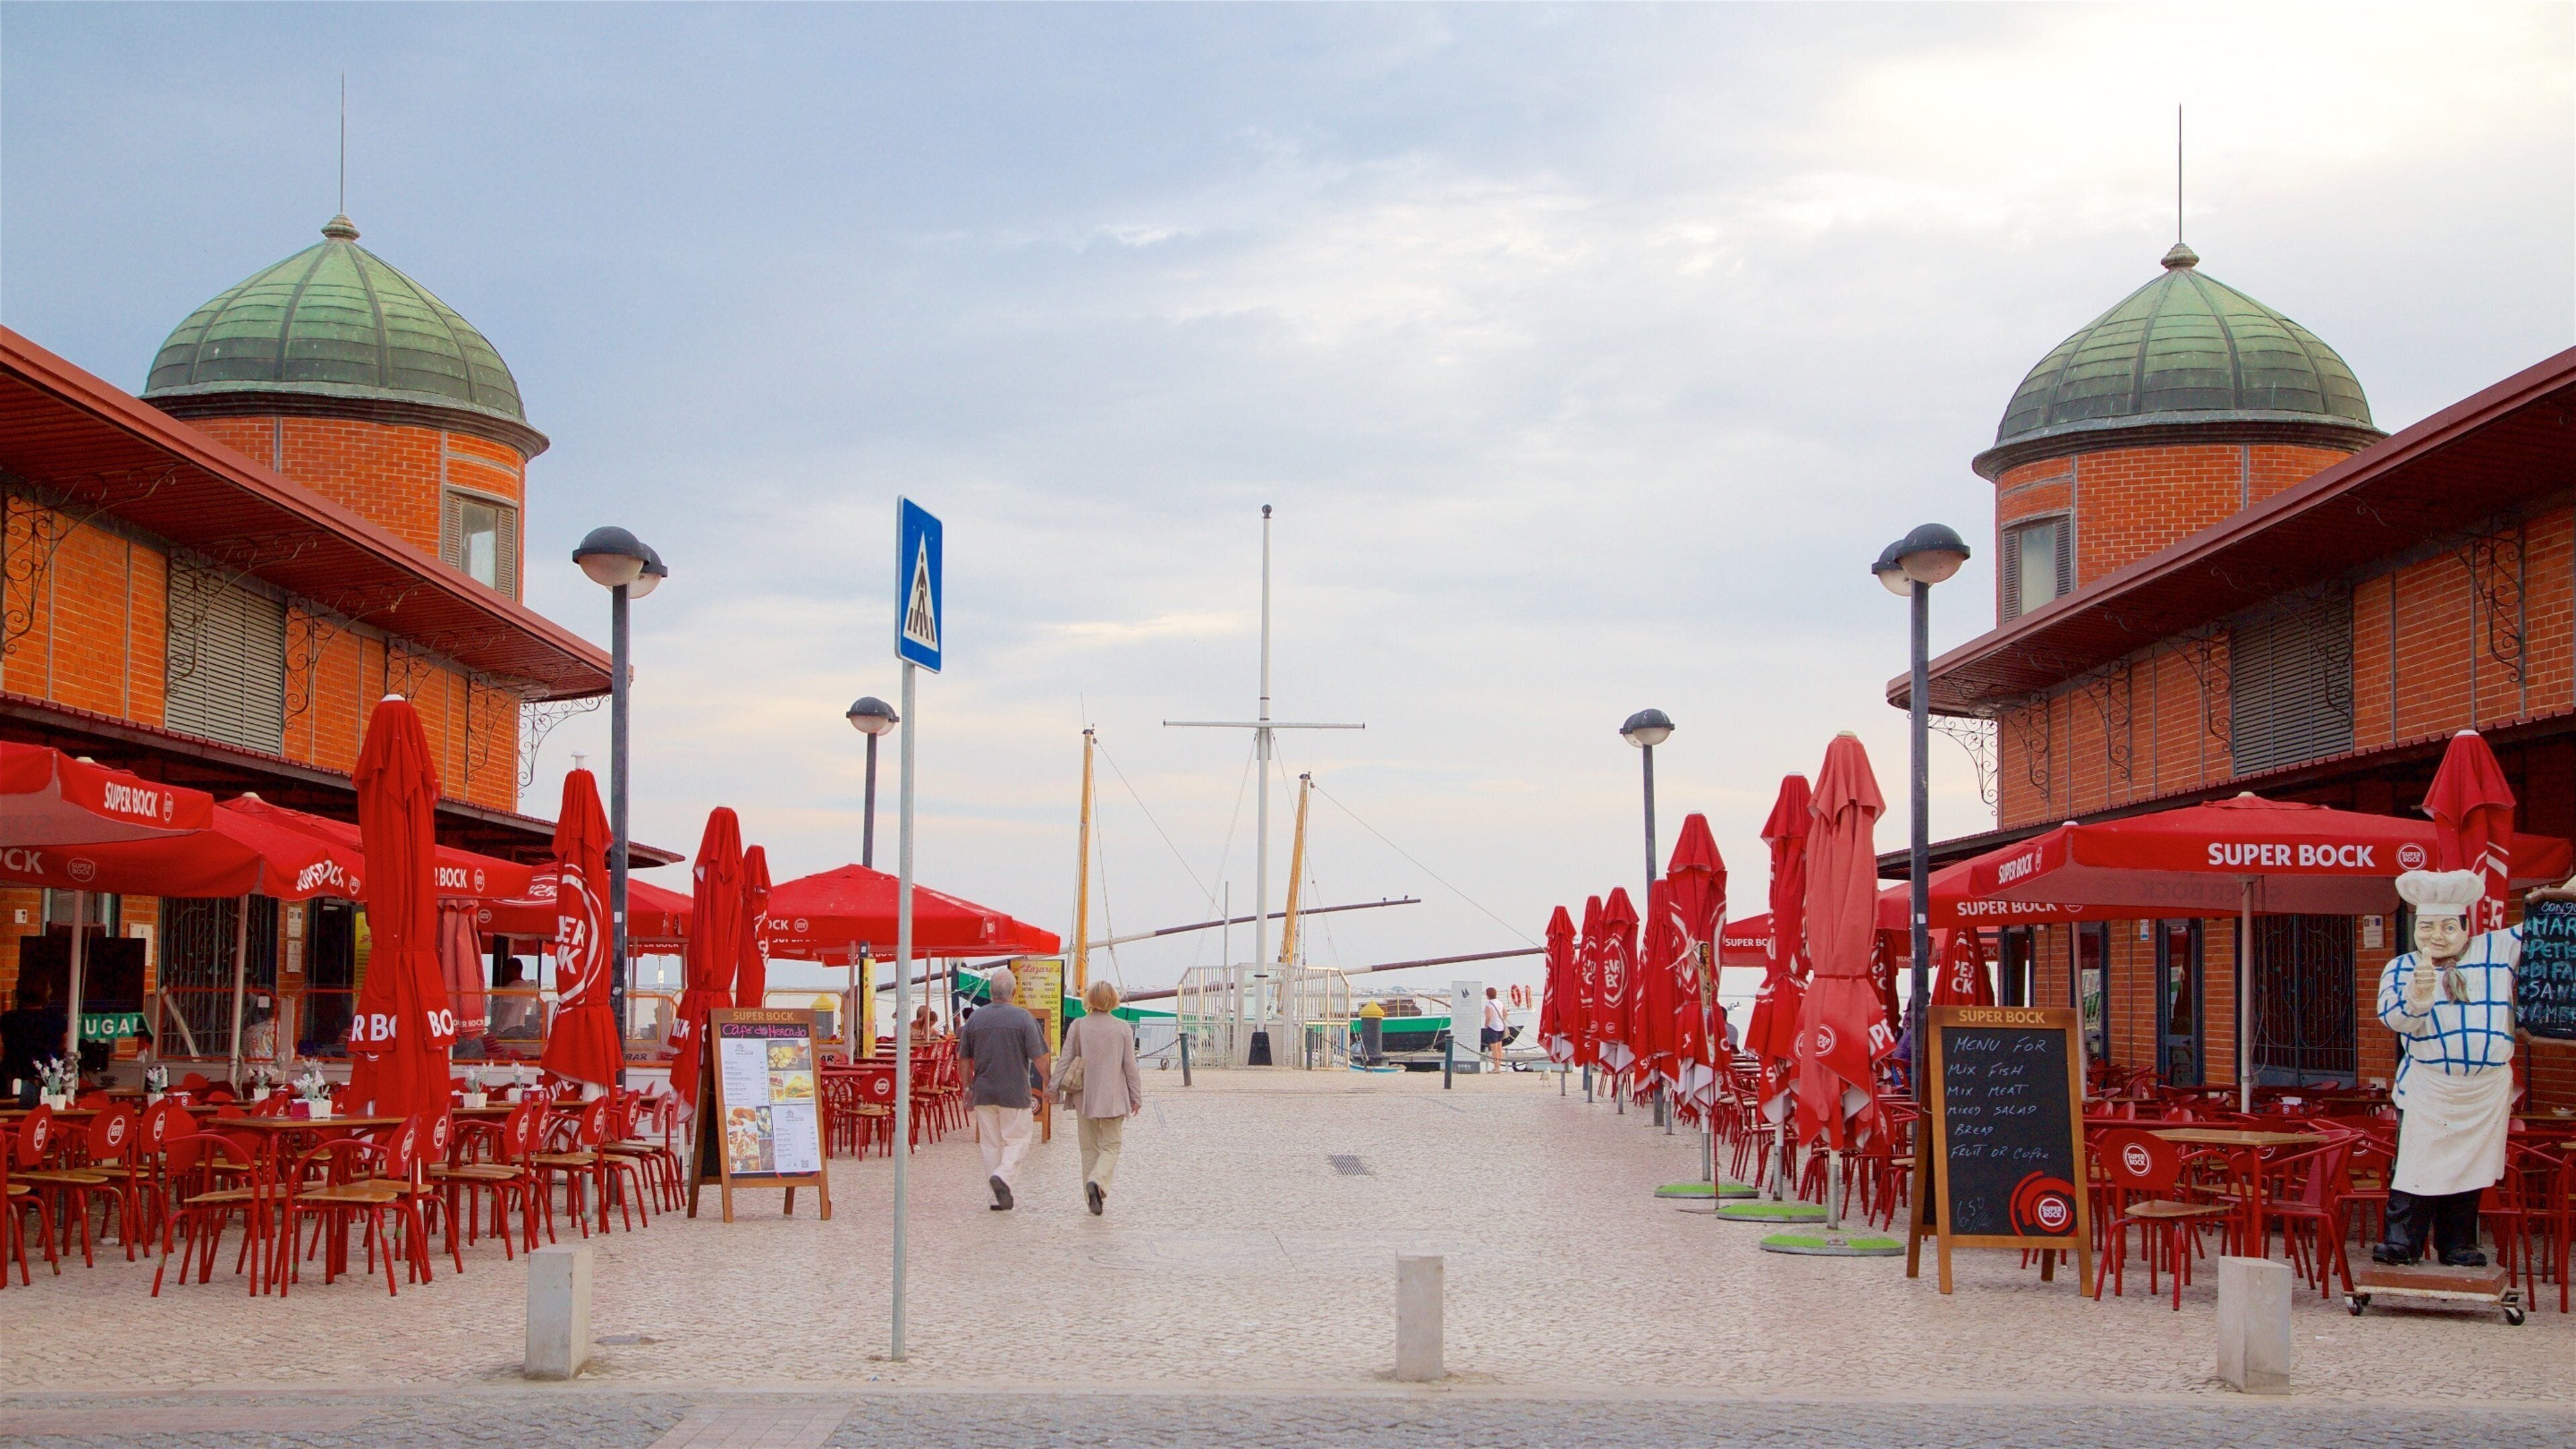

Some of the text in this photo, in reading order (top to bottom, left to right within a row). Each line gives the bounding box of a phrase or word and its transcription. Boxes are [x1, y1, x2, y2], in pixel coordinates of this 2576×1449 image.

[104, 781, 131, 813] SUPER
[132, 788, 158, 817] BOCK
[0, 848, 44, 874] CK
[2208, 843, 2375, 867] SUPER BOCK
[1998, 863, 2016, 884] SUPER
[2016, 853, 2033, 878] BOCK
[440, 868, 468, 889] BOCK
[1957, 901, 2008, 916] SUPER
[733, 1011, 794, 1021] SUPER BOCK
[1960, 1010, 2045, 1024] SUPER BOCK
[85, 1017, 144, 1034] UGAL
[722, 1024, 753, 1038] Café
[1953, 1036, 2046, 1053] MENU FOR
[1988, 1084, 2029, 1097] MEAT
[1993, 1106, 2037, 1116] SALAD
[1954, 1124, 1994, 1136] BREAD
[1991, 1146, 2008, 1157] OR
